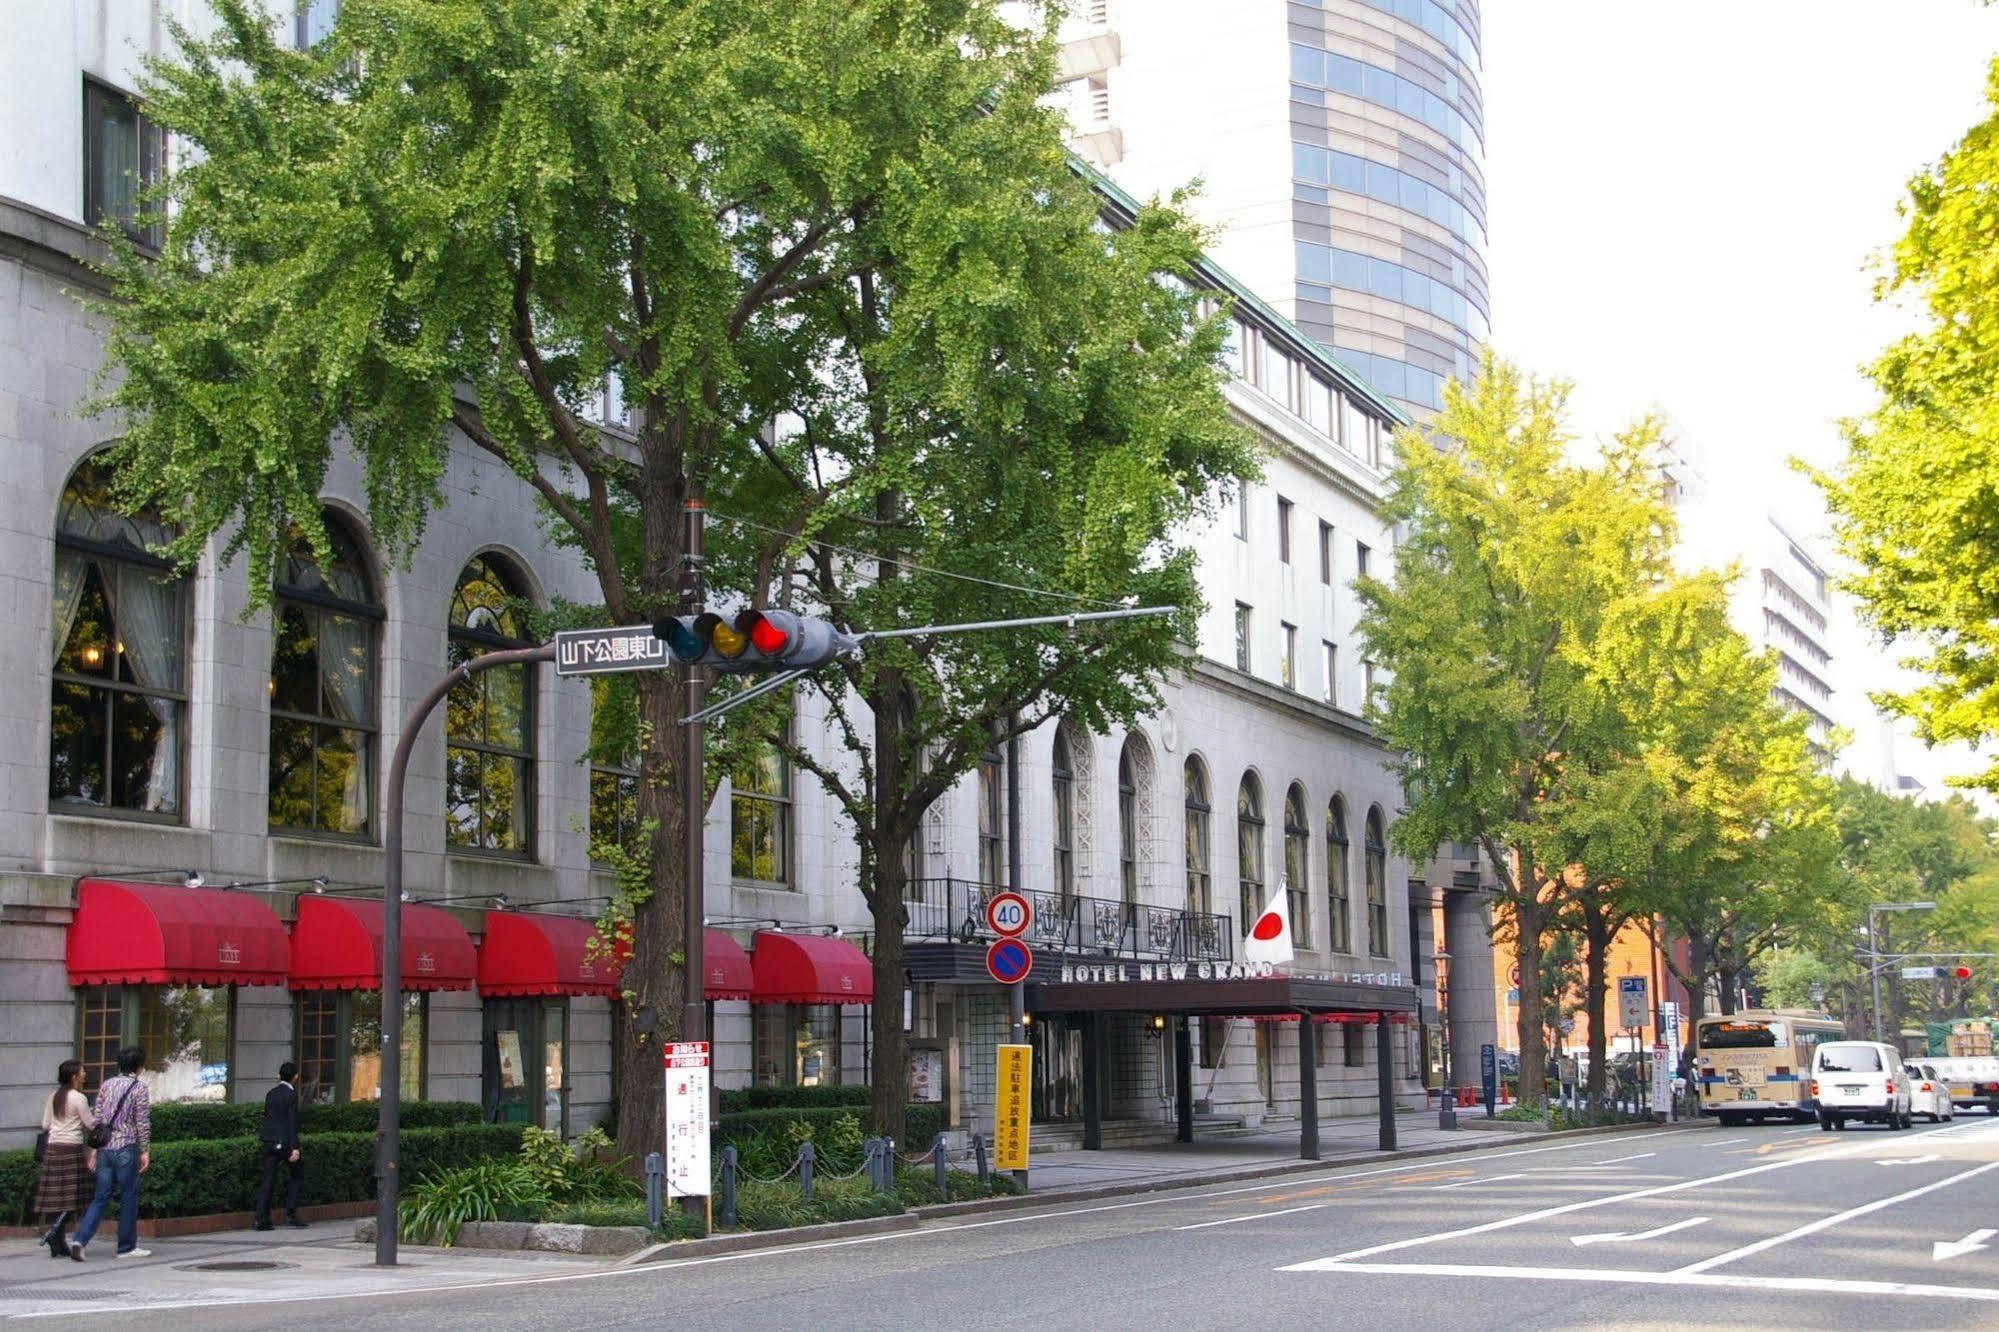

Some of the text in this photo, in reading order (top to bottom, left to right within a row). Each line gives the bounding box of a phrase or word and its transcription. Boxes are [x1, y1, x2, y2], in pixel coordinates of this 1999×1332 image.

[562, 635, 663, 665] 山下公園東口
[997, 905, 1020, 924] 40
[1061, 964, 1130, 983] HOTEL
[1140, 962, 1188, 981] NEW
[1197, 960, 1274, 980] GRAND
[1008, 1050, 1022, 1161] 違法駐車追放重点地区
